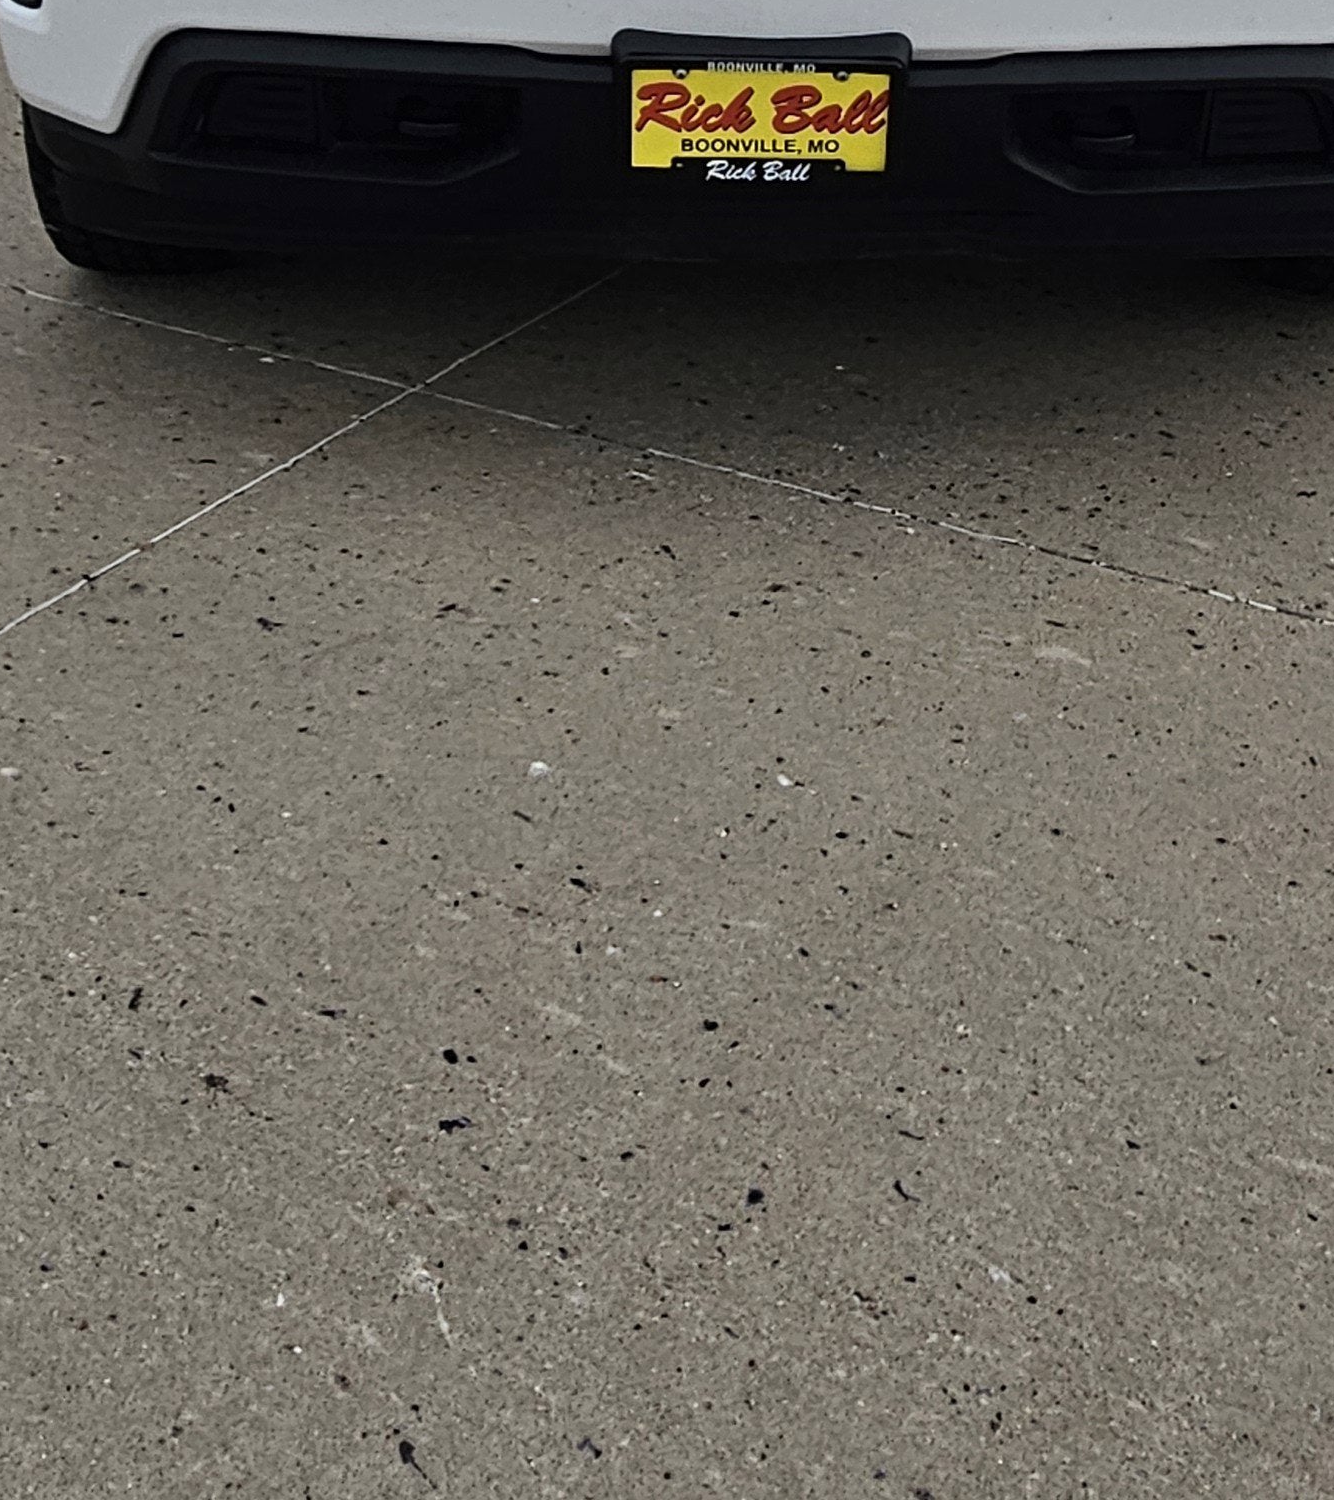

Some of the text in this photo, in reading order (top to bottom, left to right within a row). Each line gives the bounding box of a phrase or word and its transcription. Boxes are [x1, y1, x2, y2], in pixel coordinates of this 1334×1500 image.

[793, 64, 817, 74] MO
[635, 82, 890, 135] Rick Ball
[680, 138, 840, 155] BOONVILLE, MO
[705, 159, 812, 182] Rick Ball
